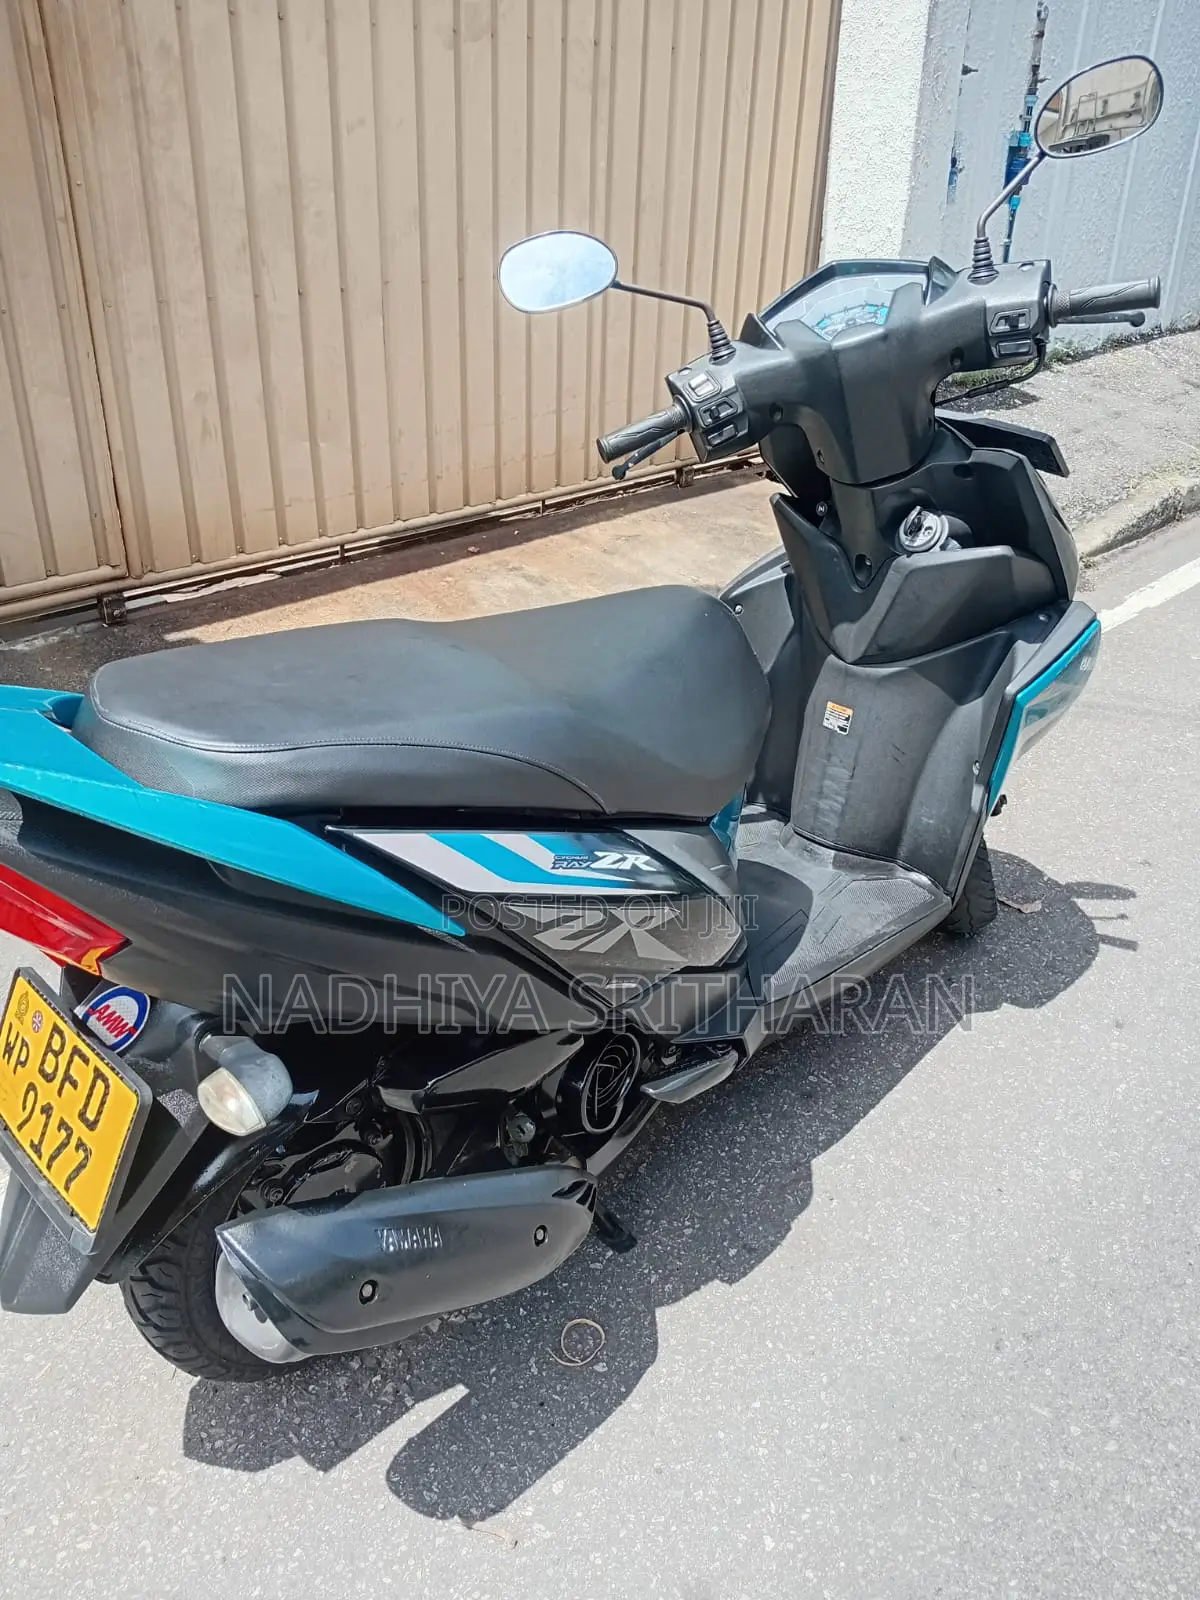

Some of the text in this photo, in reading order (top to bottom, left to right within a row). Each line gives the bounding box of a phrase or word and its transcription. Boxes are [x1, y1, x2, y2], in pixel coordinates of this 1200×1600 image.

[590, 851, 657, 872] ZR
[2, 1021, 110, 1132] WP BFD
